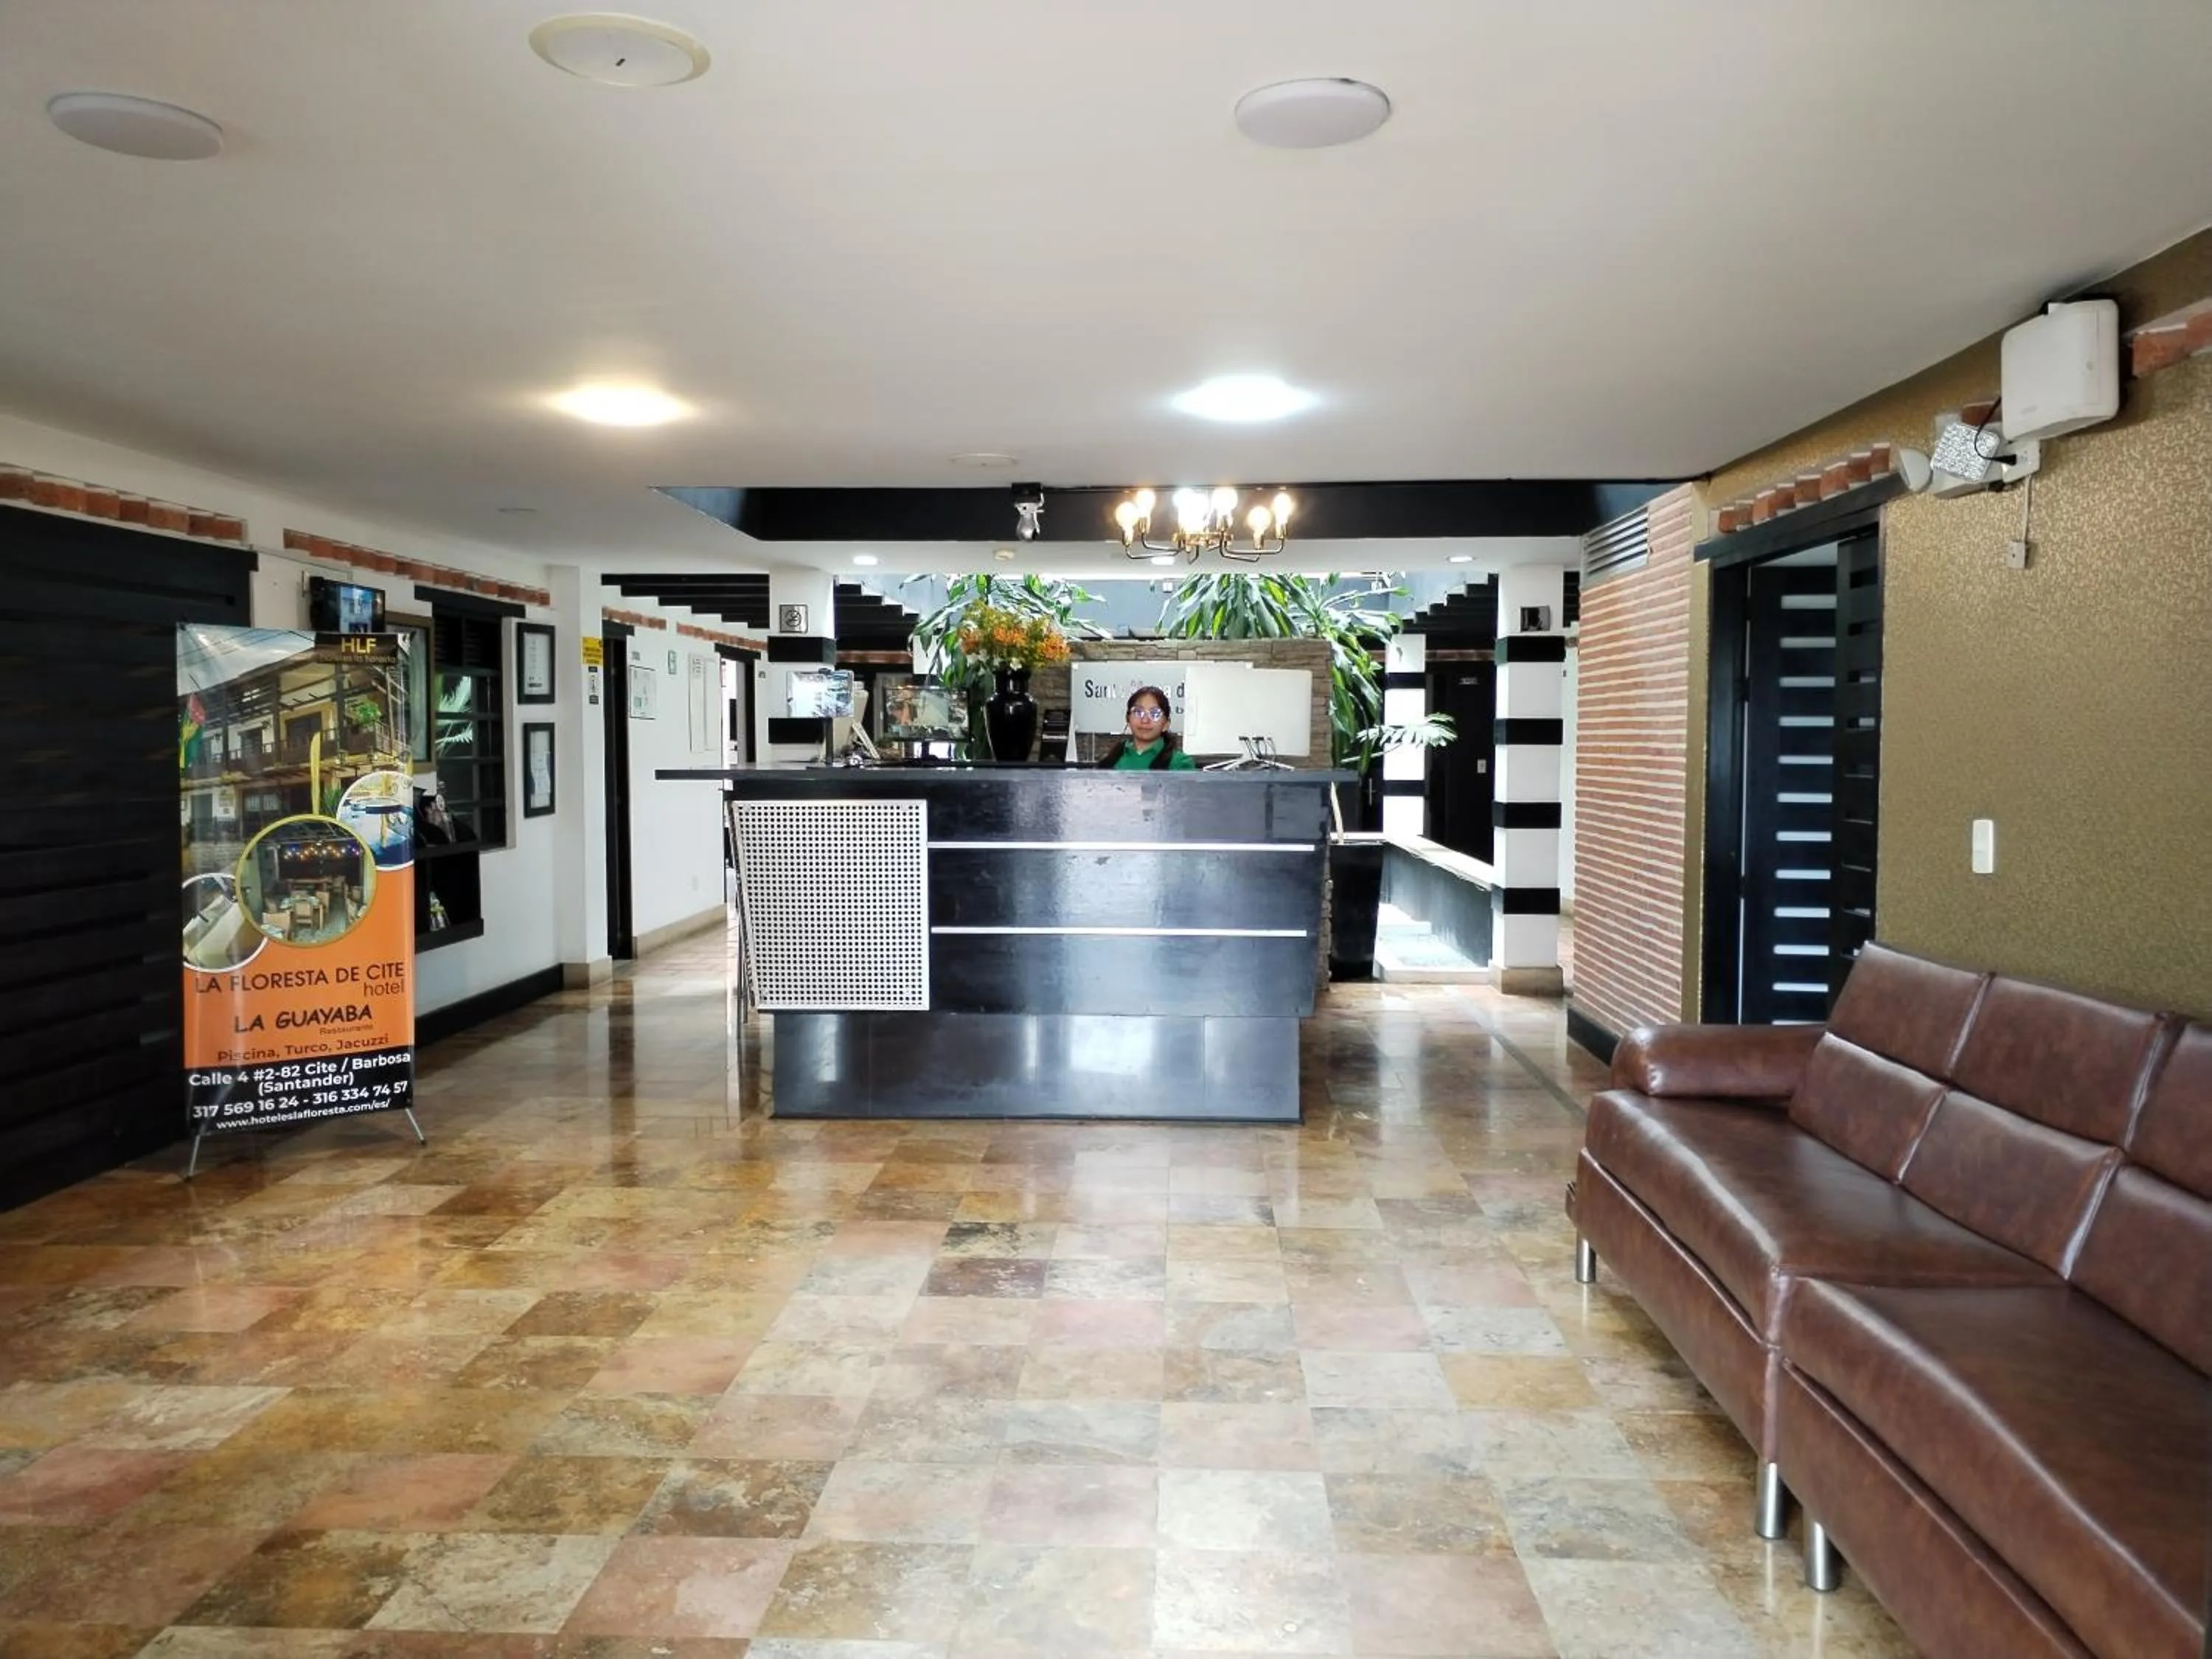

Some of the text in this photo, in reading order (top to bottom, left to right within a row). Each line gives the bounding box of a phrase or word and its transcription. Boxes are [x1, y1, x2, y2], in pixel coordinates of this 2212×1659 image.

[341, 638, 377, 654] HLF
[195, 961, 404, 992] LA FLORESTA DE CITE
[364, 978, 405, 997] hotel
[234, 1004, 372, 1033] LA GUAYABA
[217, 1033, 389, 1062] Piscina, Turco, Jacuzzi
[188, 1074, 233, 1086] Calle
[237, 1072, 248, 1083] 4
[254, 1065, 301, 1081] #2-82
[305, 1061, 337, 1075] Cite
[352, 1052, 411, 1070] Barbosa
[258, 1072, 354, 1096] (Santander)
[192, 1105, 219, 1119] 317
[223, 1102, 254, 1116] 569
[258, 1099, 275, 1112] 16
[279, 1096, 299, 1109] 24
[313, 1091, 338, 1105] 316
[341, 1087, 369, 1101] 334
[372, 1084, 391, 1096] 74
[394, 1080, 408, 1093] 57
